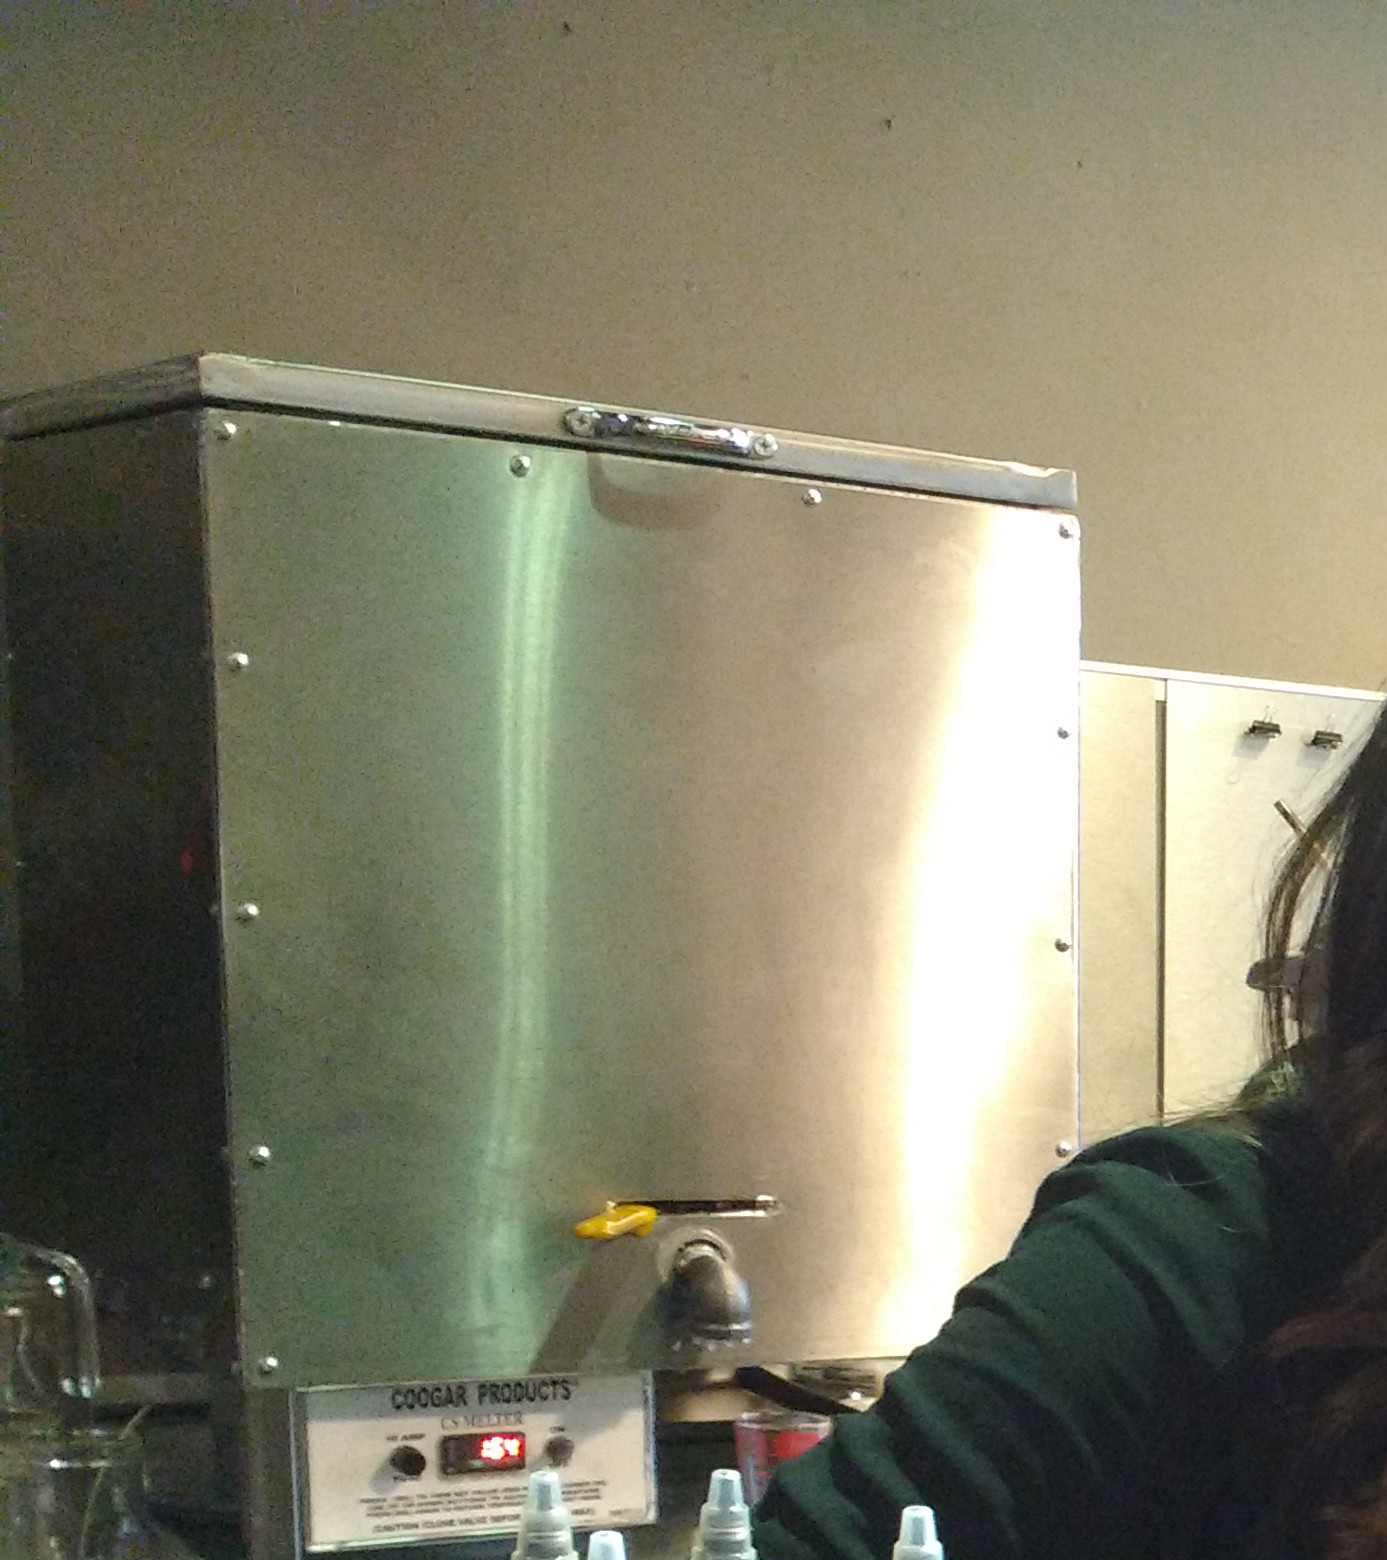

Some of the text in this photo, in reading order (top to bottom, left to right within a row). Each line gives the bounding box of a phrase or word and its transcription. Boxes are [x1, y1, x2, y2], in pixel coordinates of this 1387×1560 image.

[391, 1378, 572, 1411] COOGAR PRODUCTS
[464, 1411, 523, 1428] MELTER
